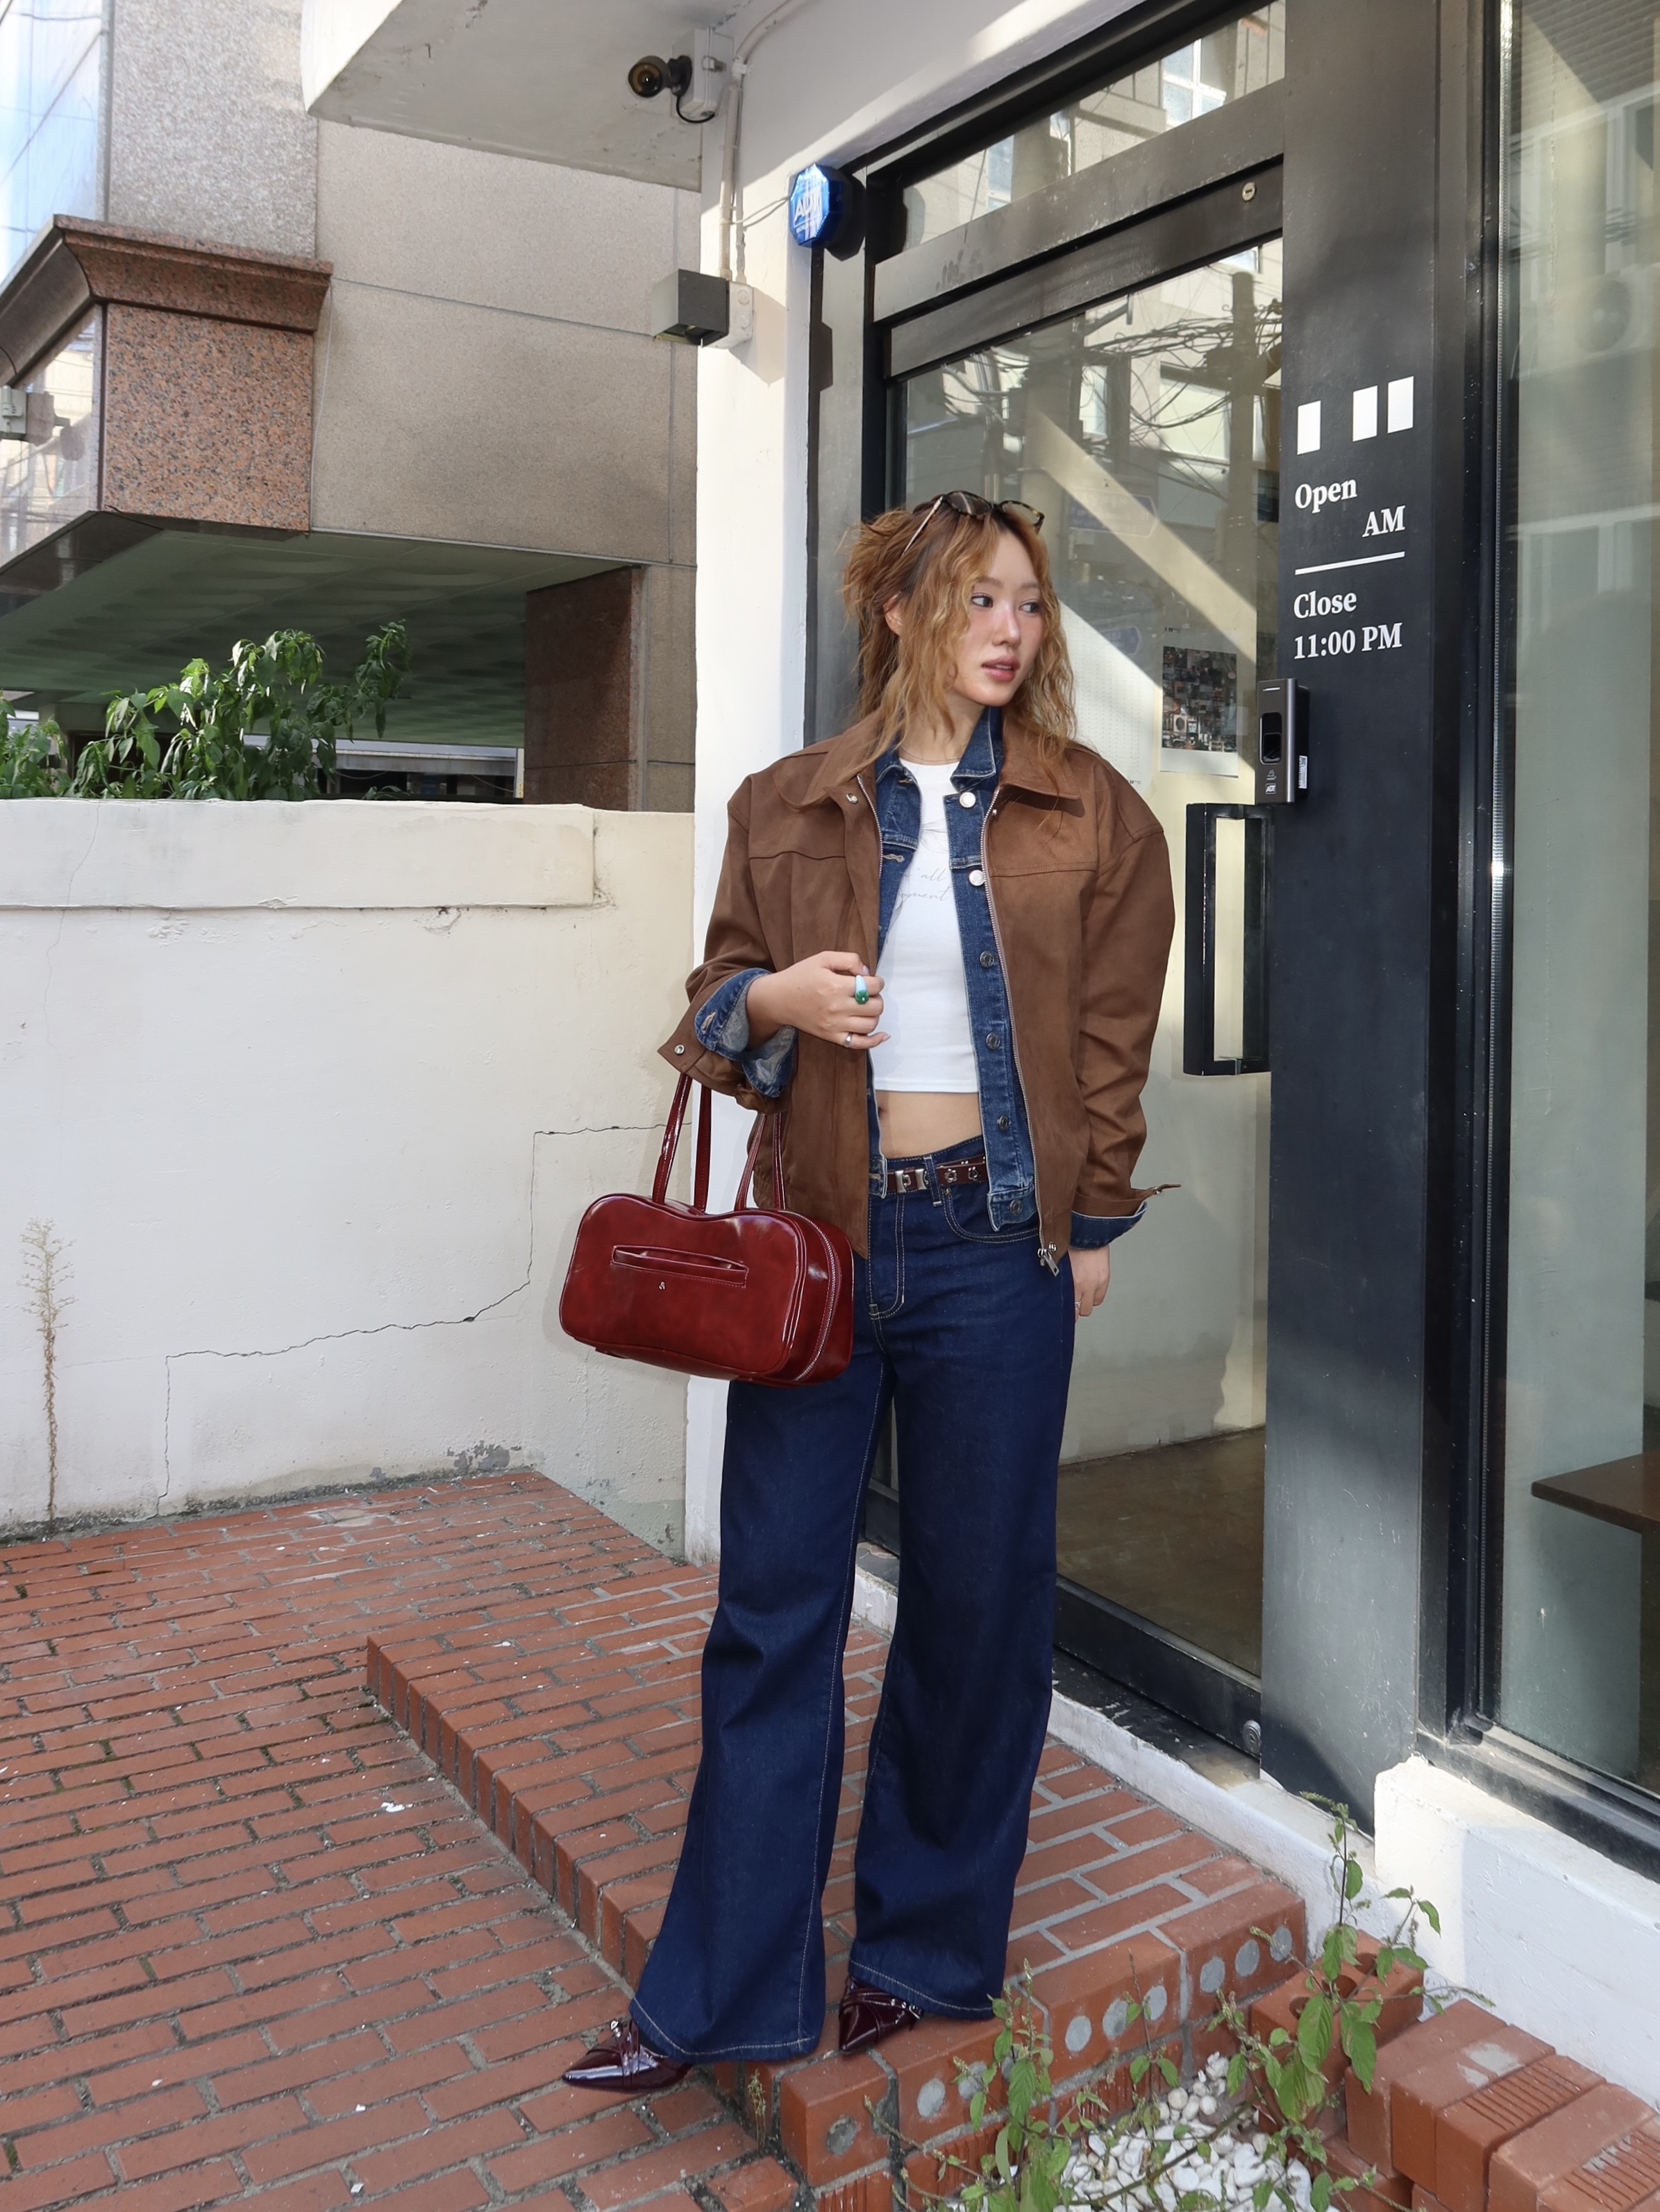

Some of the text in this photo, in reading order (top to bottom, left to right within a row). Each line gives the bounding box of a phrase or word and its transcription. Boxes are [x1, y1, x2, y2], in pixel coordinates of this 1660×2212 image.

[1294, 479, 1358, 514] Open
[1361, 505, 1406, 538] AM
[1293, 590, 1357, 619] Close
[1293, 622, 1403, 659] 11:00 PM
